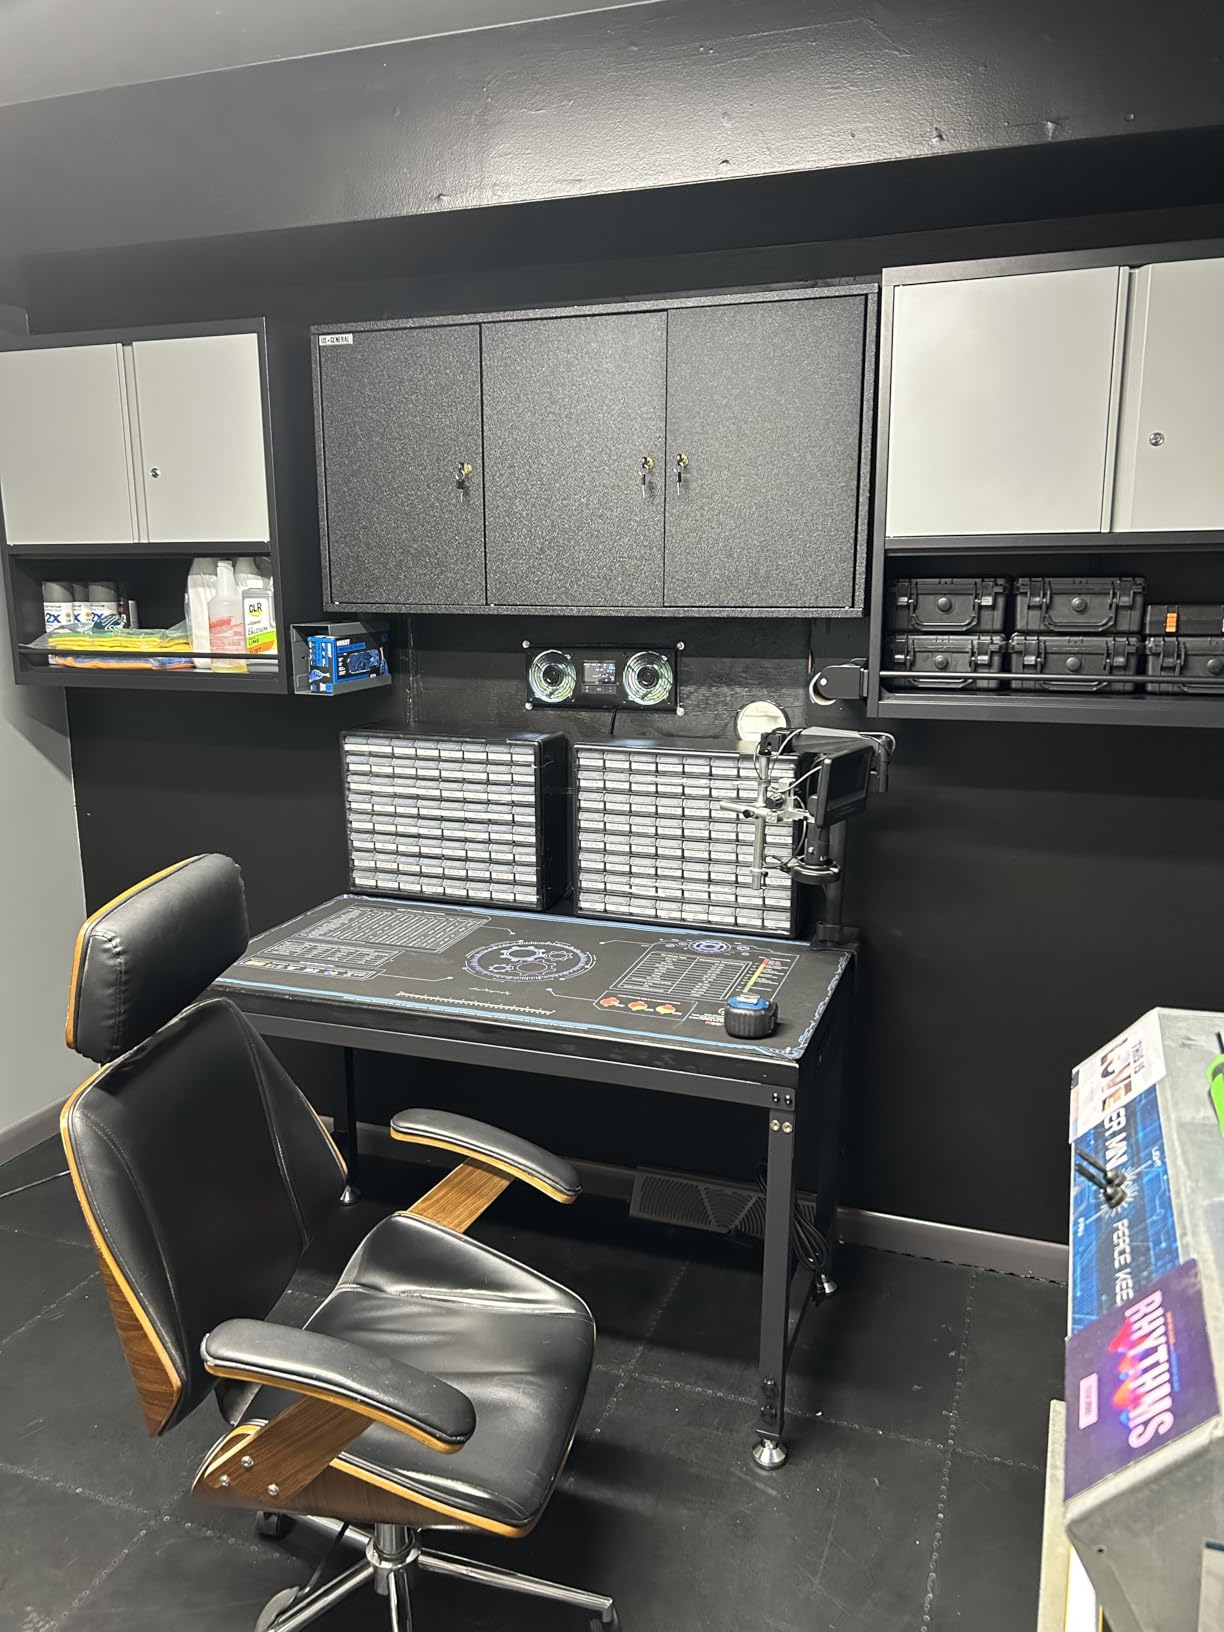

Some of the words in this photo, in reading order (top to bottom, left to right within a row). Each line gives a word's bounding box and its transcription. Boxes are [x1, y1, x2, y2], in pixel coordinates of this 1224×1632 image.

[46, 612, 61, 623] 2X
[249, 602, 262, 613] CLR
[1131, 1040, 1144, 1063] THIS
[1112, 1218, 1132, 1269] PEACE
[1114, 1268, 1134, 1307] KEE
[1125, 1290, 1174, 1448] RHYTHMS
